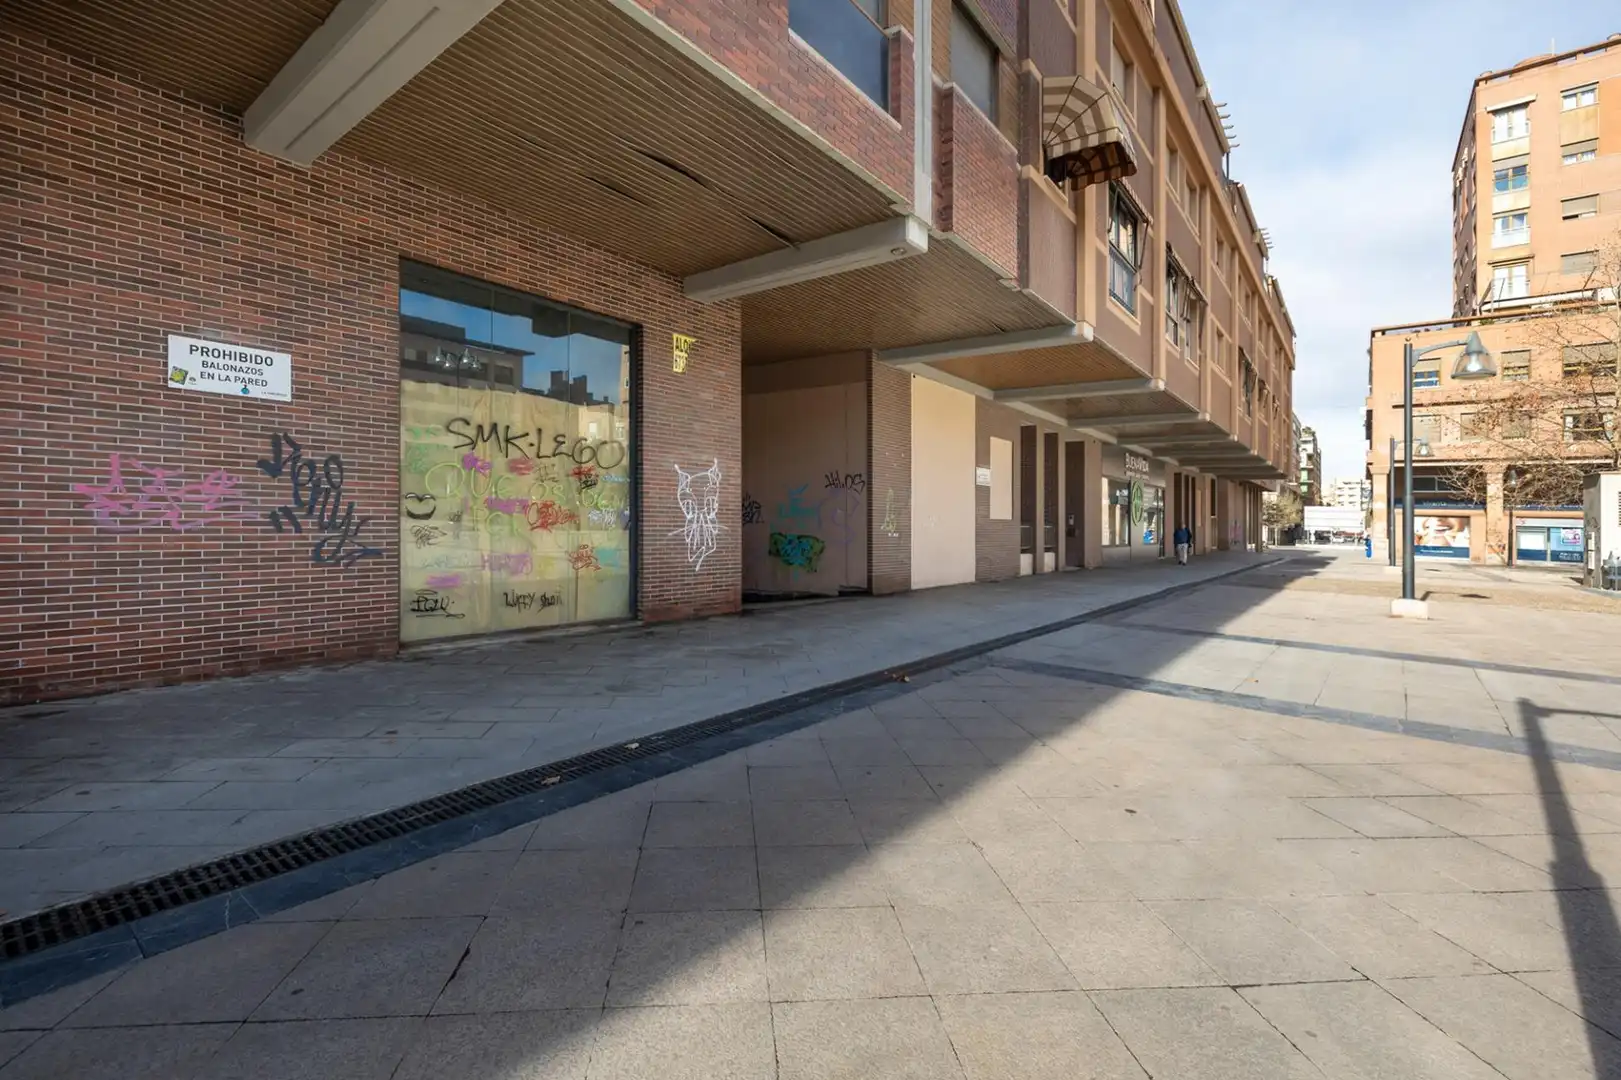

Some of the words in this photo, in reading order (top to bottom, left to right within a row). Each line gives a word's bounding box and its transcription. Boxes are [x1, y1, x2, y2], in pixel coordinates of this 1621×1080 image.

[189, 344, 274, 367] PROHIBIDO
[201, 360, 264, 376] BALONAZOS
[200, 371, 215, 381] EN
[218, 374, 232, 383] LA
[234, 376, 268, 388] PARED
